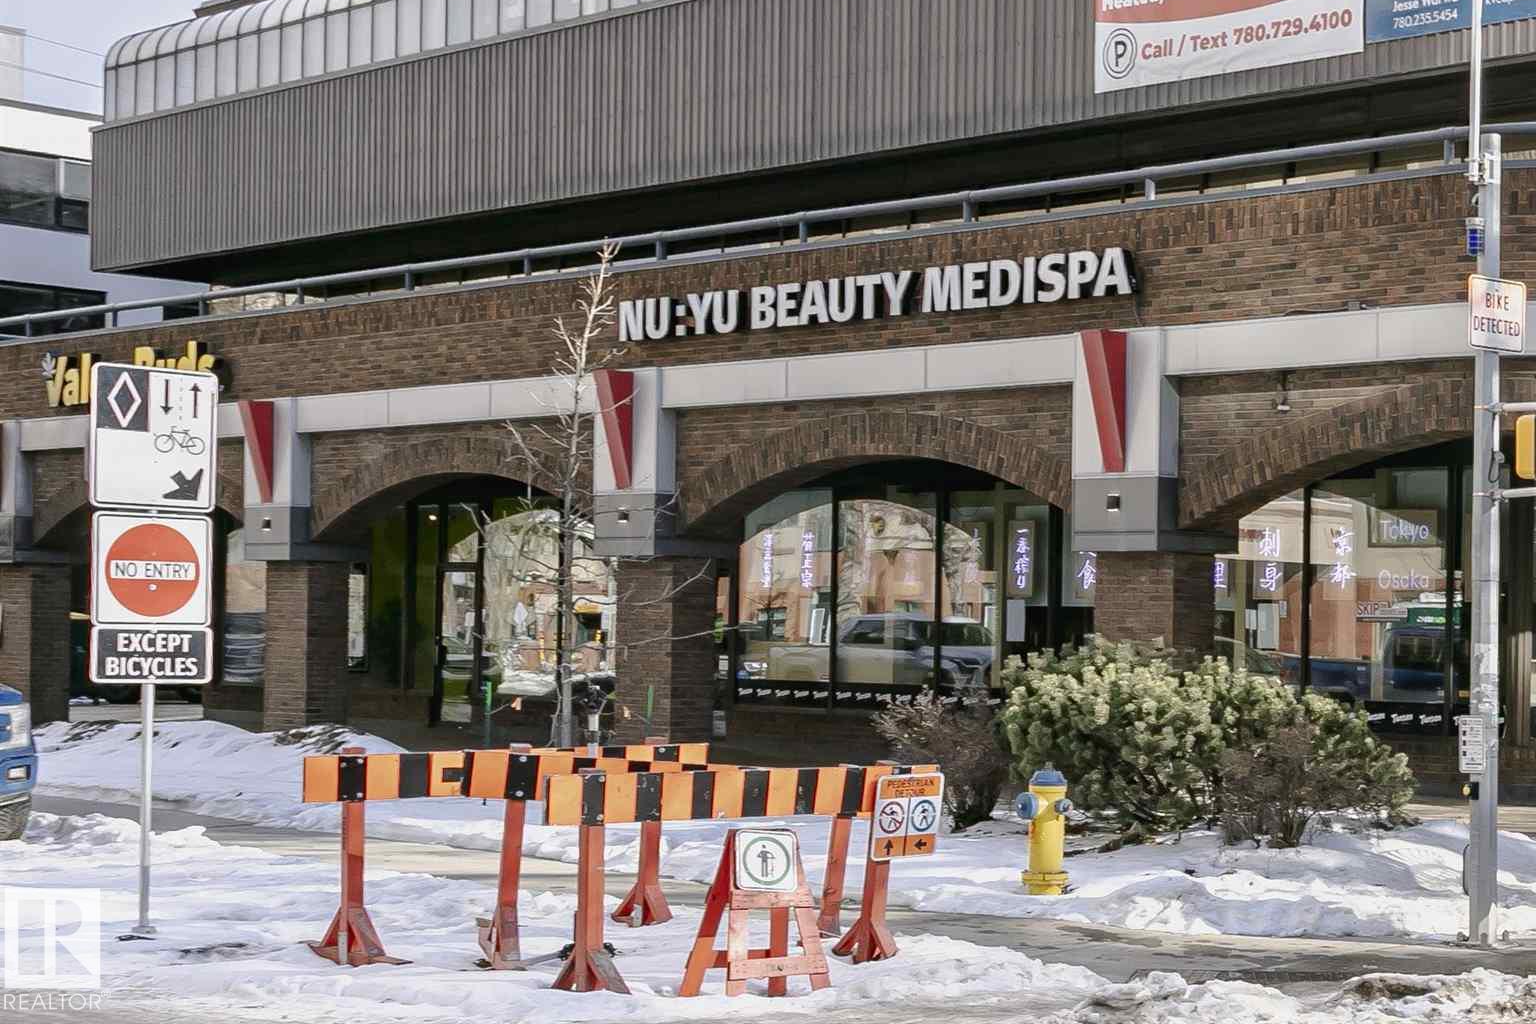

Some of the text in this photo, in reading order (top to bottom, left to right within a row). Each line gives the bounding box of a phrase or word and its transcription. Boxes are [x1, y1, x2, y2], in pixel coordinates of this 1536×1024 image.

[1392, 8, 1458, 29] 780.235.5454
[1141, 39, 1173, 60] Call
[1190, 31, 1228, 52] Text
[1232, 8, 1353, 45] 780.729.4100
[618, 247, 1133, 342] NU:YU BEAUTY MEDISPA
[1486, 292, 1509, 311] BIKE
[1473, 315, 1521, 337] DETECTED
[1381, 519, 1429, 543] Tokyo
[114, 562, 191, 578] NO ENTRY
[1378, 569, 1430, 590] Osaka
[116, 633, 192, 653] EXCEPT
[105, 656, 199, 677] BICYCLES
